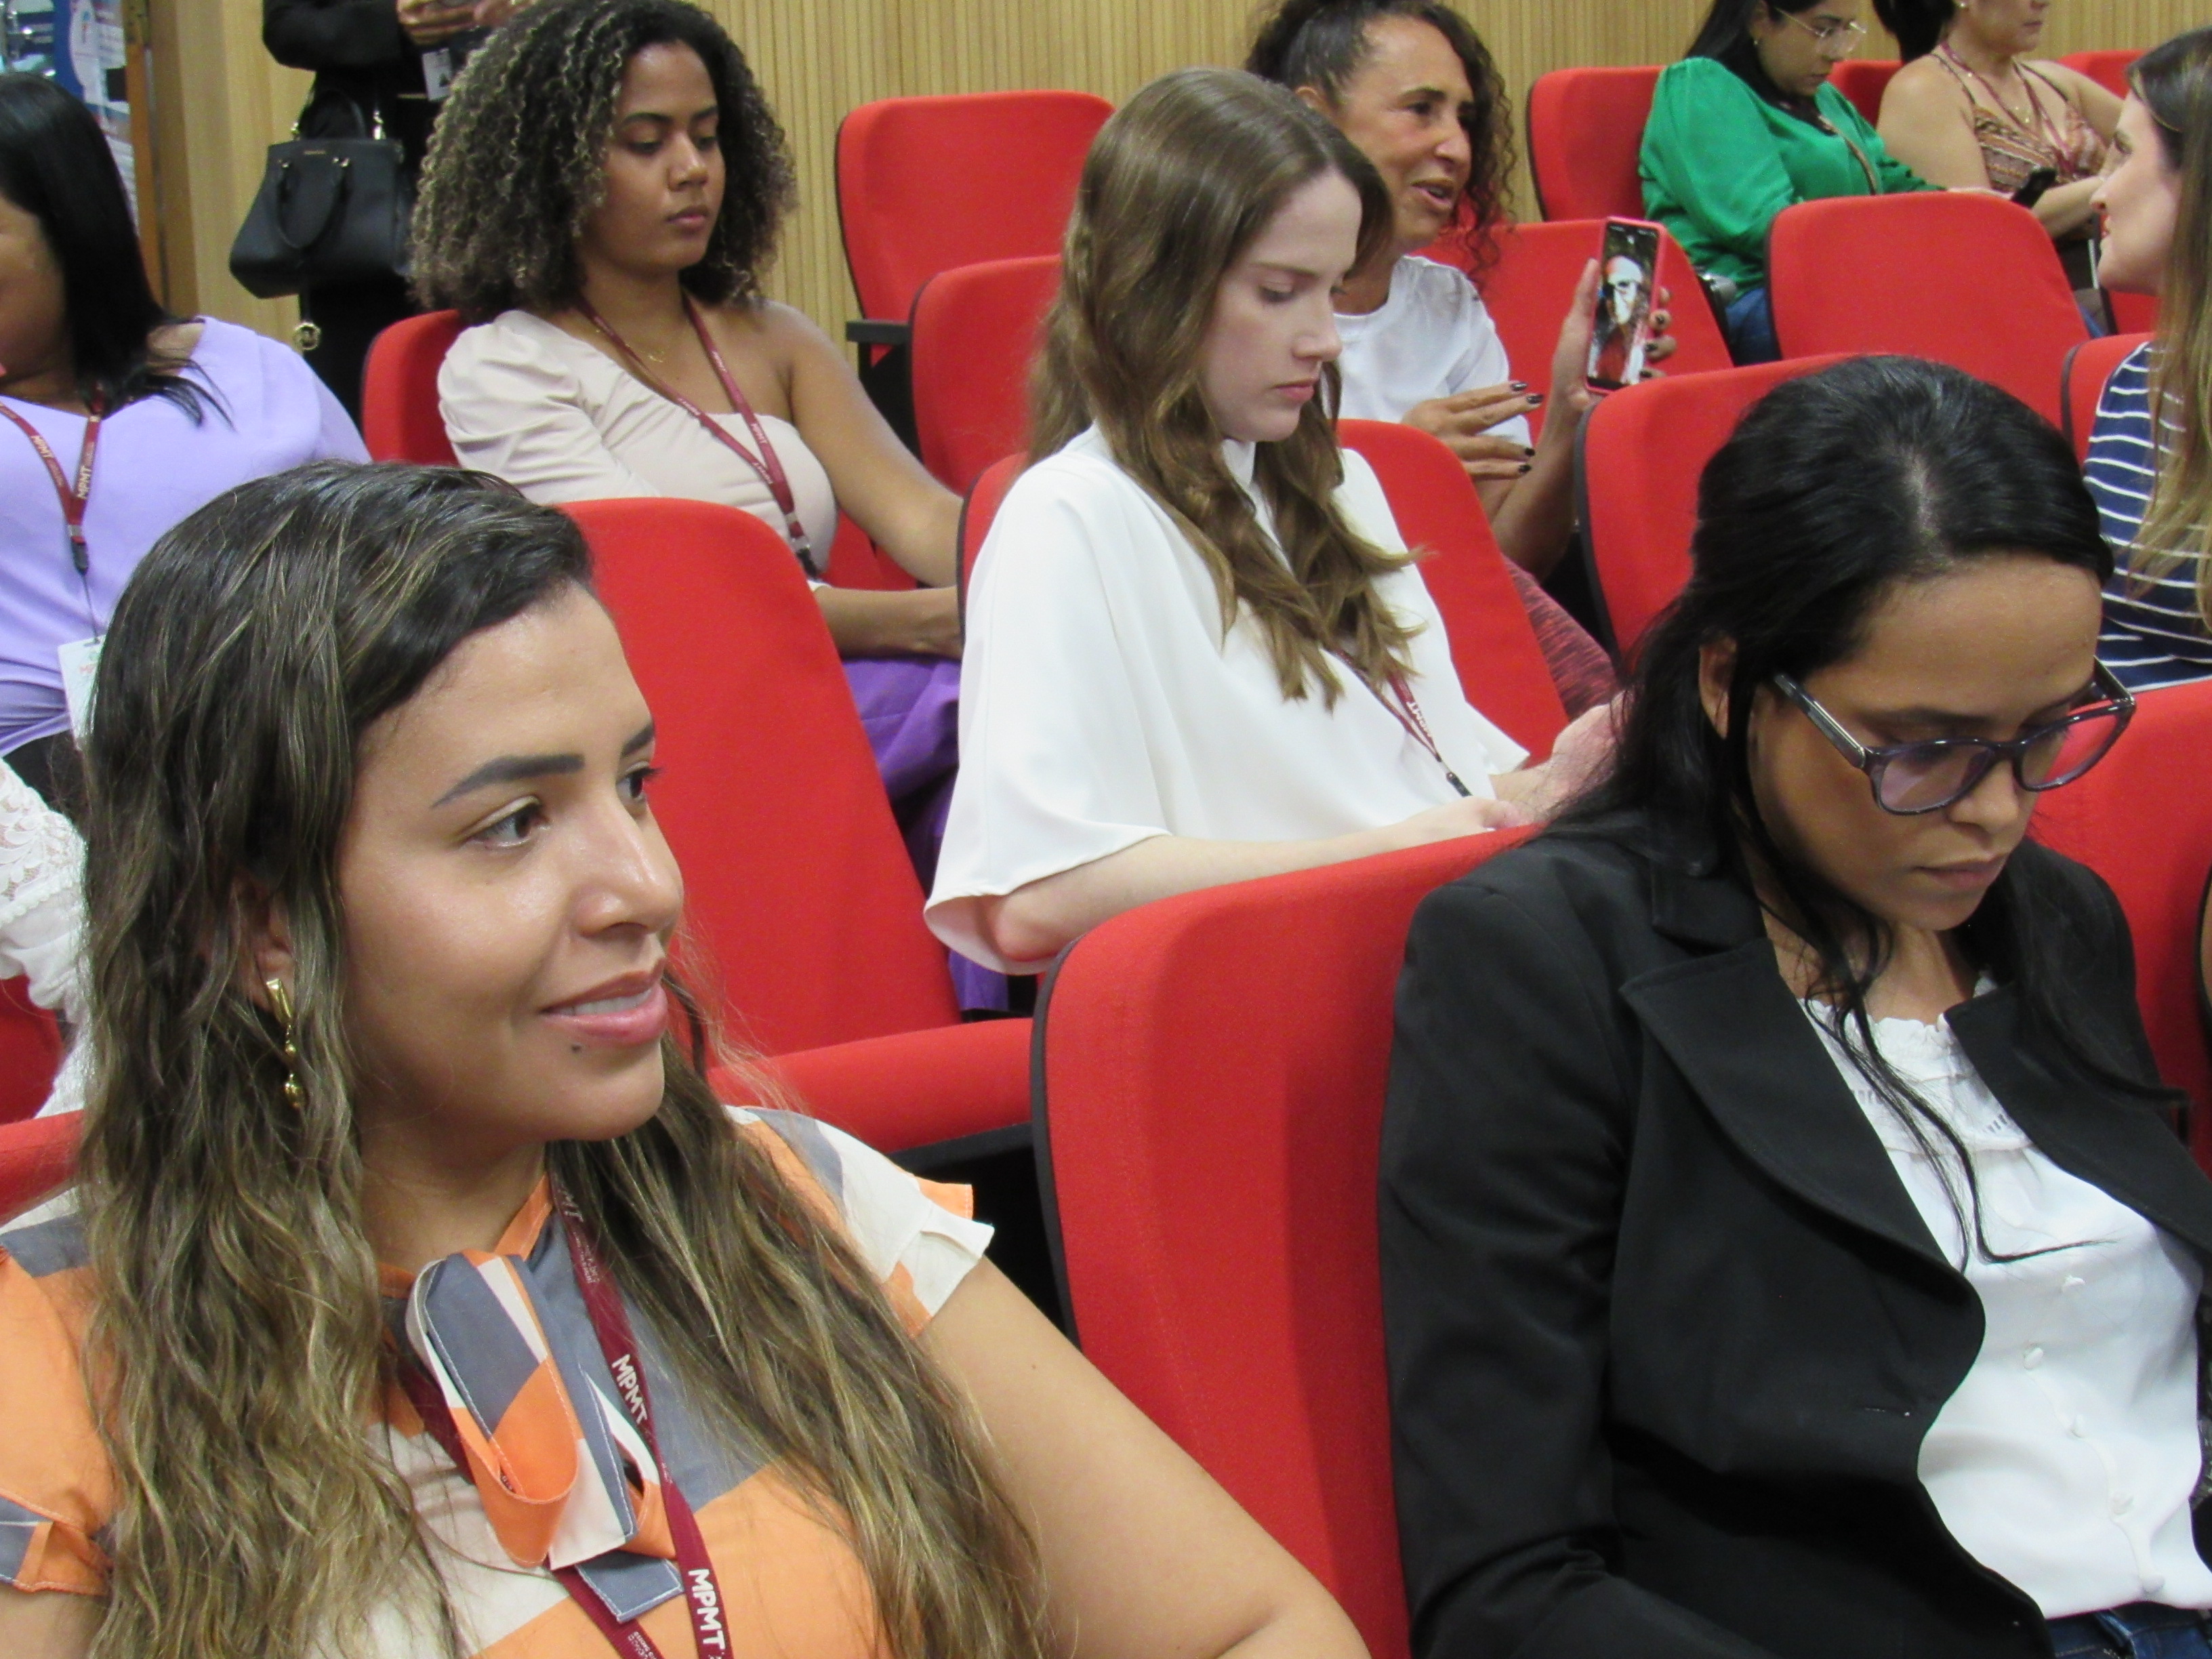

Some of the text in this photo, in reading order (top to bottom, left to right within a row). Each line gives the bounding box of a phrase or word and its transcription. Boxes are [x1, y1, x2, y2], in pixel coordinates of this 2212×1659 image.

[31, 435, 54, 458] MPMT
[76, 466, 92, 499] MPMT
[612, 1353, 648, 1424] MPMT
[687, 1568, 726, 1650] MPMT
